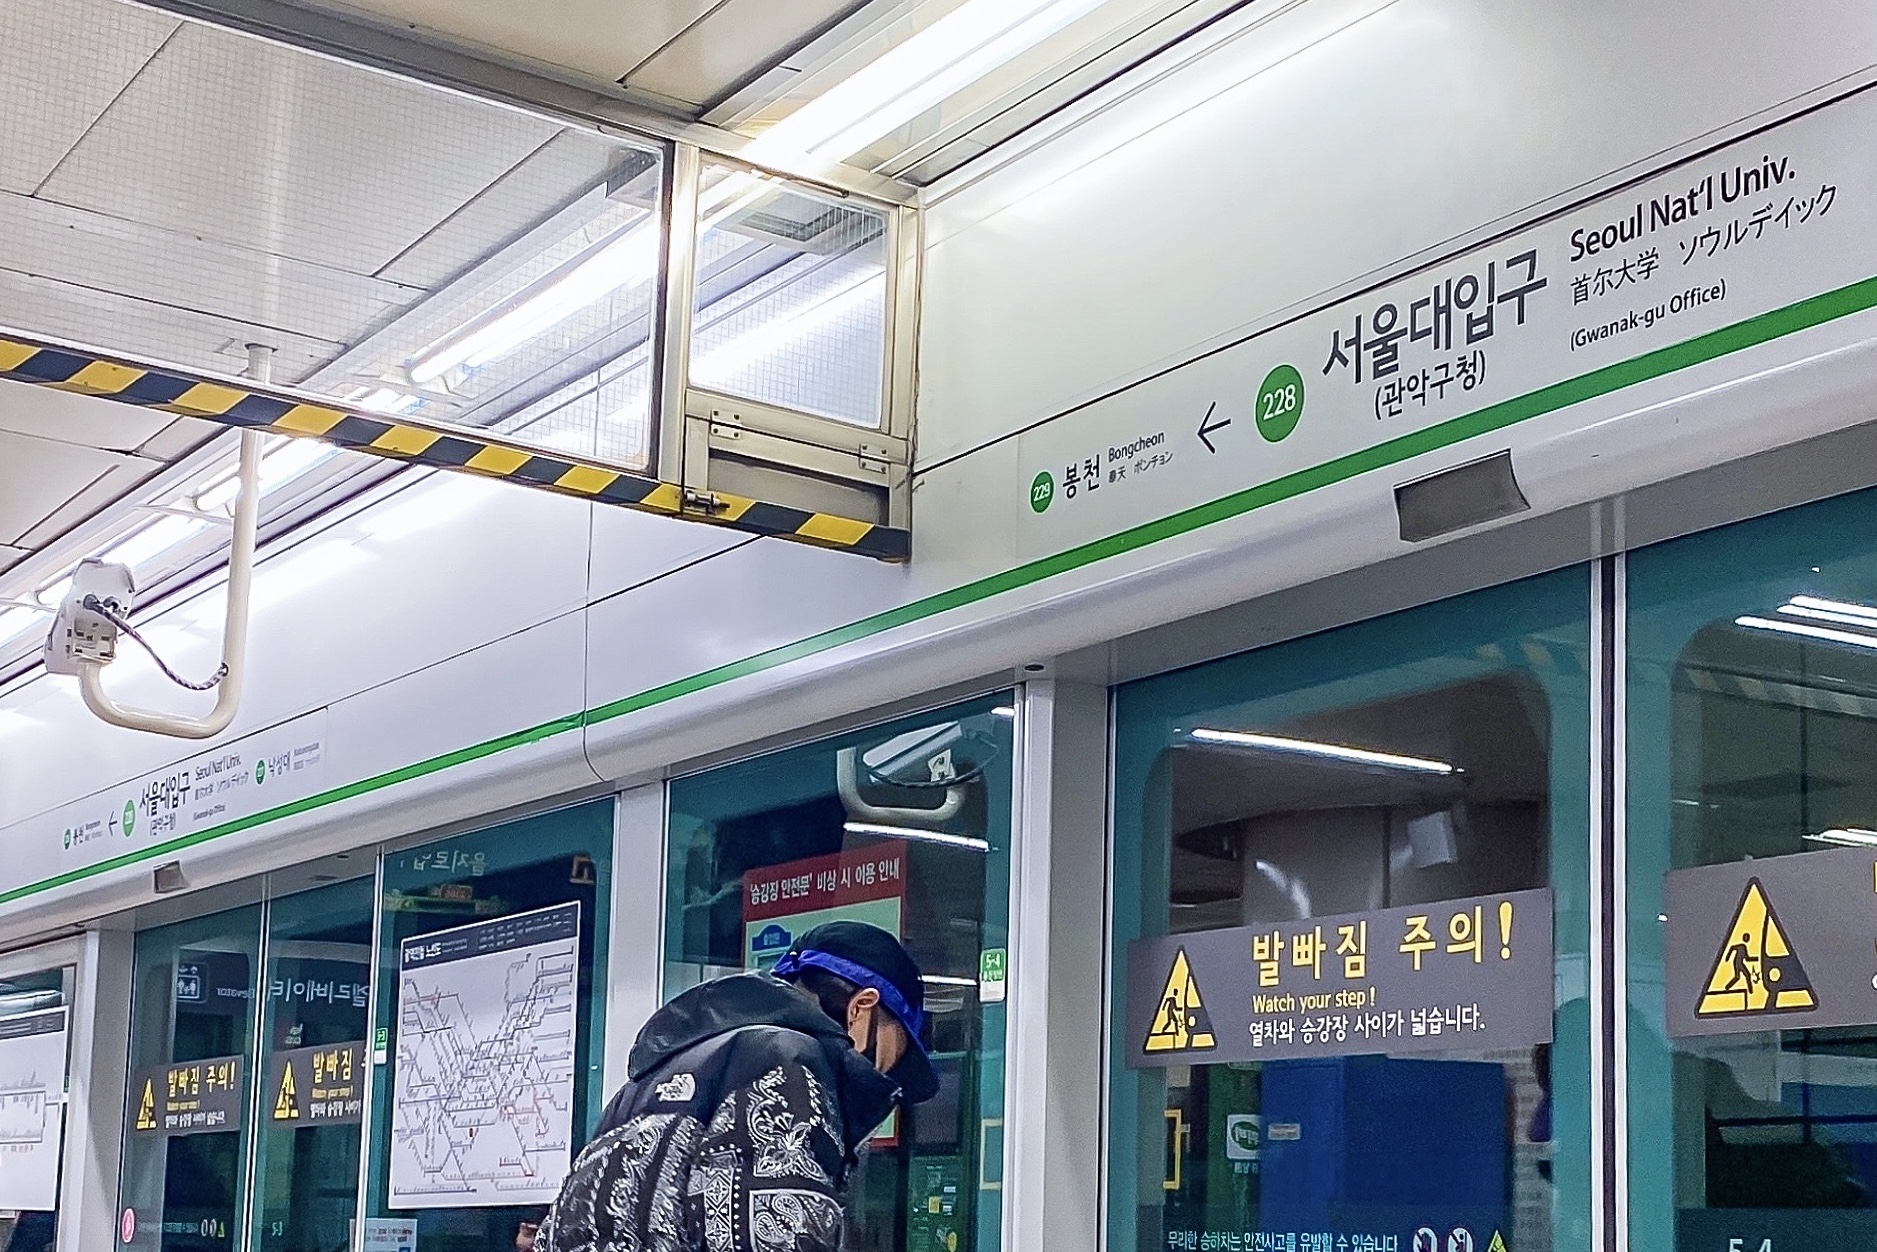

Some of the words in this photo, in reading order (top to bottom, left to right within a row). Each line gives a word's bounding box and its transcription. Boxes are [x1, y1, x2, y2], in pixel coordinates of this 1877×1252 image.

[1570, 203, 1643, 262] Seoul
[1650, 176, 1713, 232] Nat'l
[1720, 155, 1796, 203] Univ.
[1570, 247, 1660, 306] 首尔大学
[1322, 248, 1548, 384] 서울대입구
[1570, 304, 1666, 351] (Gwanak-gu
[1669, 278, 1726, 314] Office)
[1262, 384, 1297, 420] 228
[1374, 350, 1486, 420] (관악구청)
[1108, 431, 1165, 463] Bongcheon
[1033, 481, 1051, 502] 229
[1062, 453, 1101, 499] 봉천
[139, 771, 191, 817] 서울대입구
[817, 869, 837, 891] 비상
[840, 867, 851, 888] 시
[855, 862, 876, 886] 이용
[878, 857, 900, 881] 안내
[1252, 920, 1368, 987] 발빠짐
[1399, 901, 1514, 971] 주의!
[1249, 1018, 1295, 1048] 열차와
[1299, 1013, 1349, 1045] 승강장
[1354, 1009, 1405, 1039] 사이가
[1410, 1002, 1487, 1037] 넓습니다.
[1252, 993, 1295, 1014] Watch
[1299, 993, 1332, 1016] your
[313, 1048, 352, 1084] 발빠짐
[1167, 1230, 1198, 1251] 무리한
[1200, 1231, 1241, 1252] 승하차는
